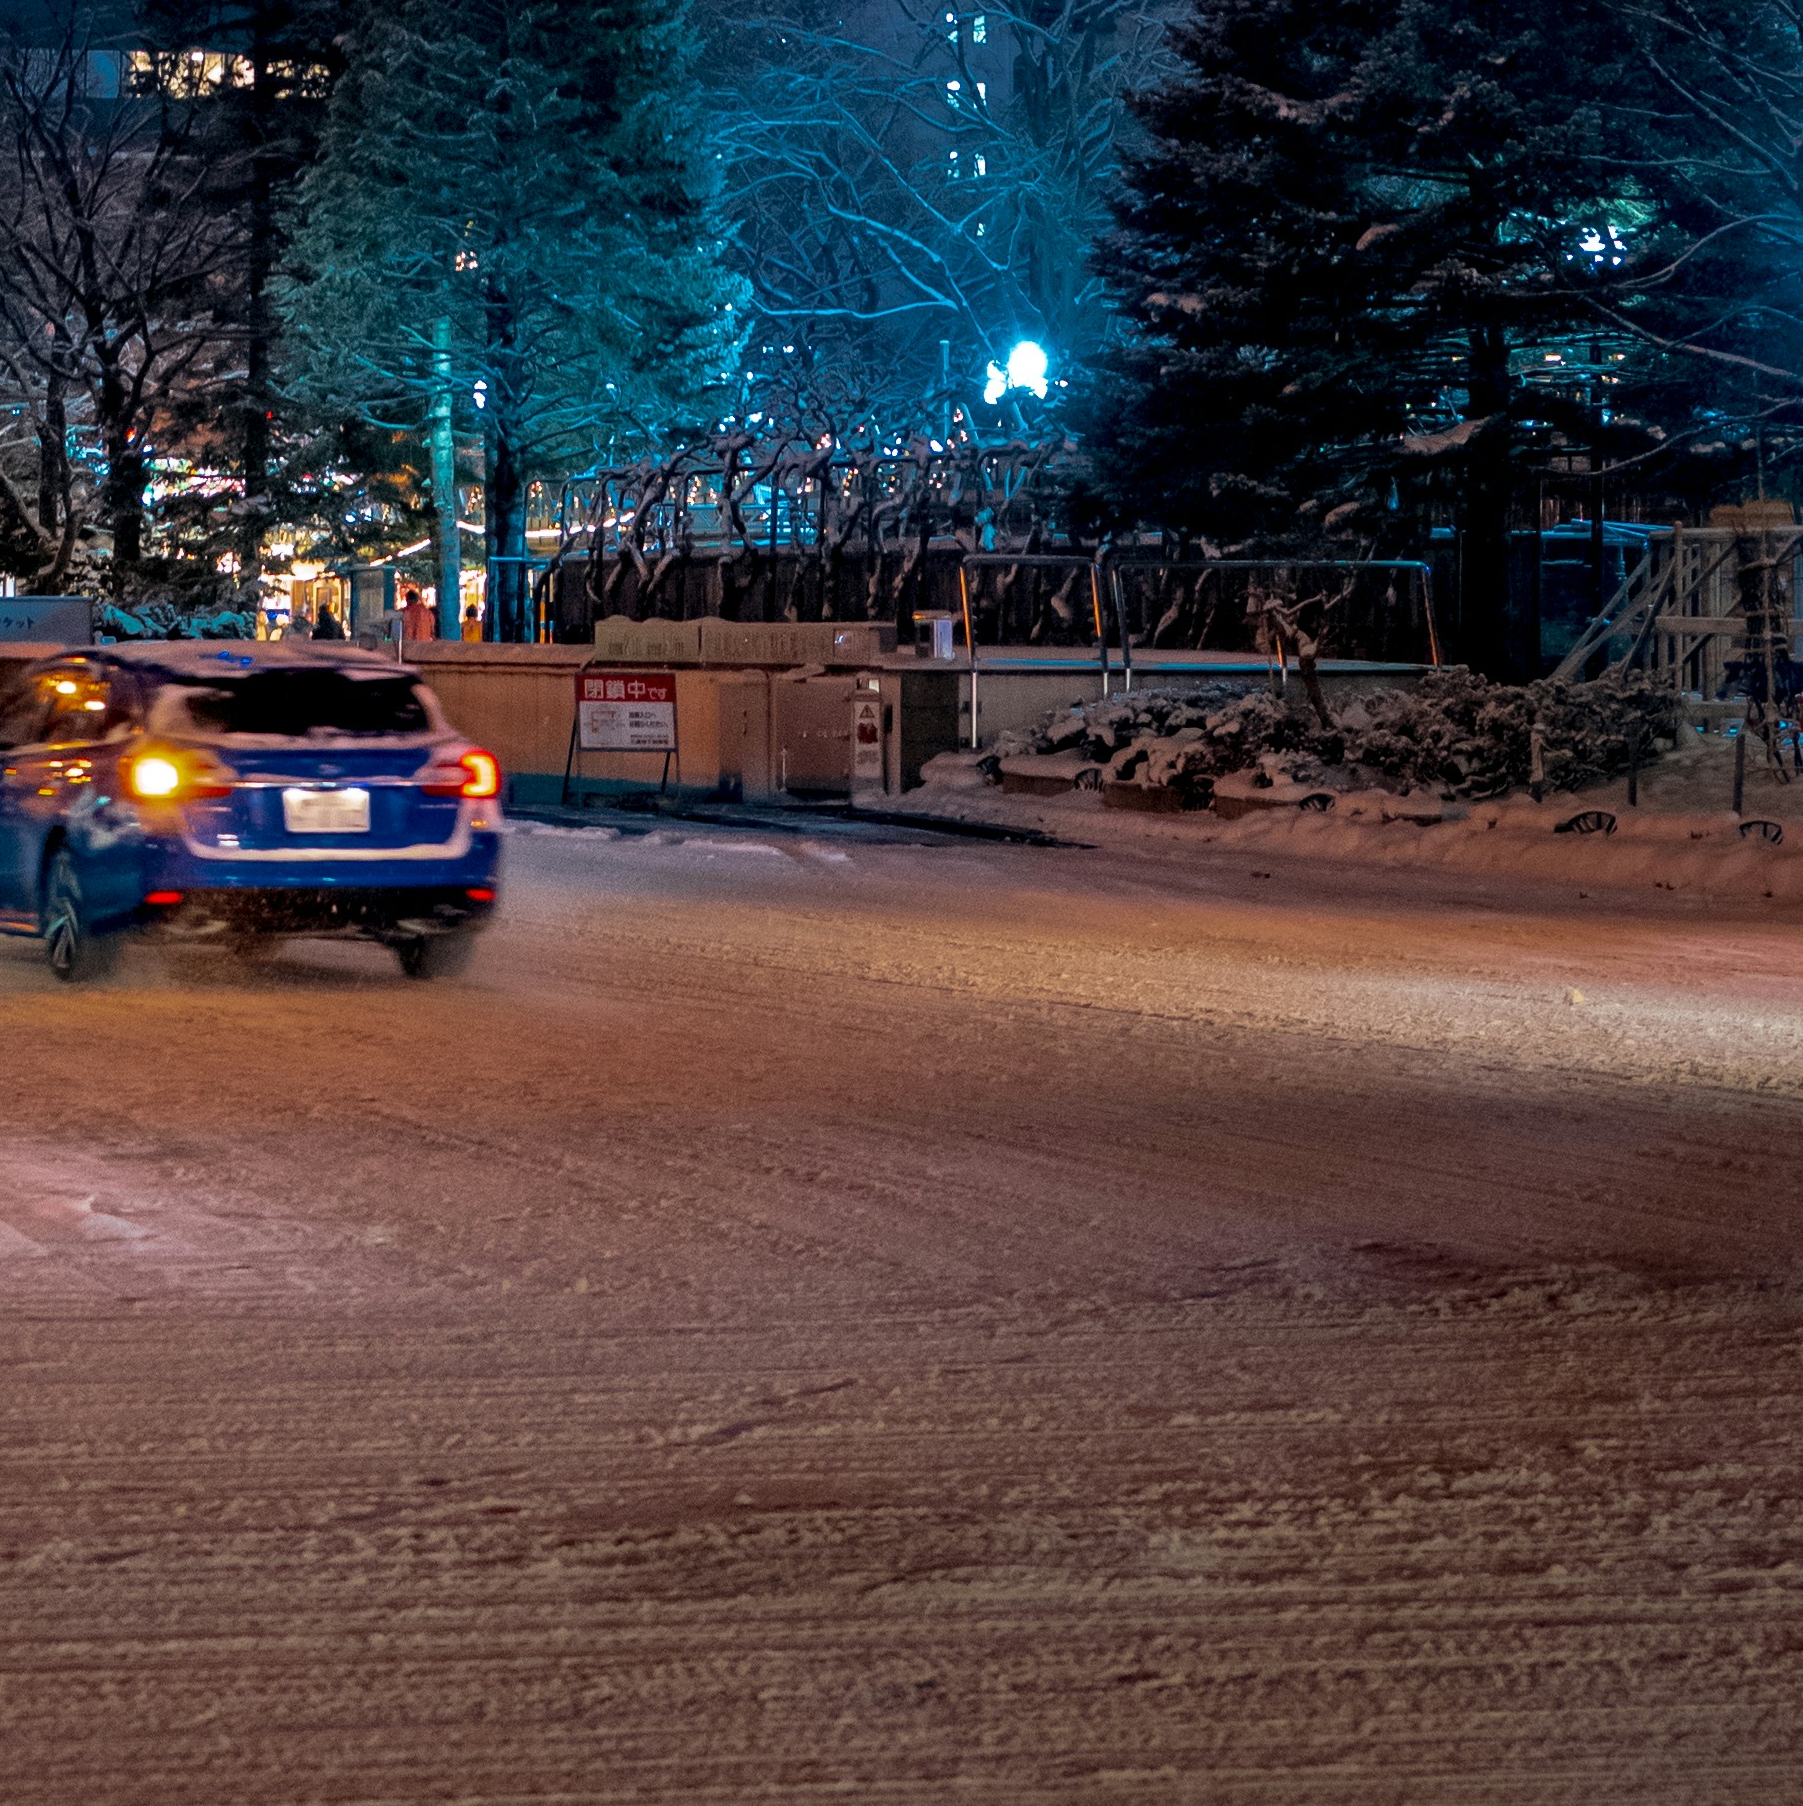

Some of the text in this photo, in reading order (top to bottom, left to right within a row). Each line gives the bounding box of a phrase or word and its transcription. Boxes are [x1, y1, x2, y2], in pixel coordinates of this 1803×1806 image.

[584, 678, 668, 700] 閉鎖中です
